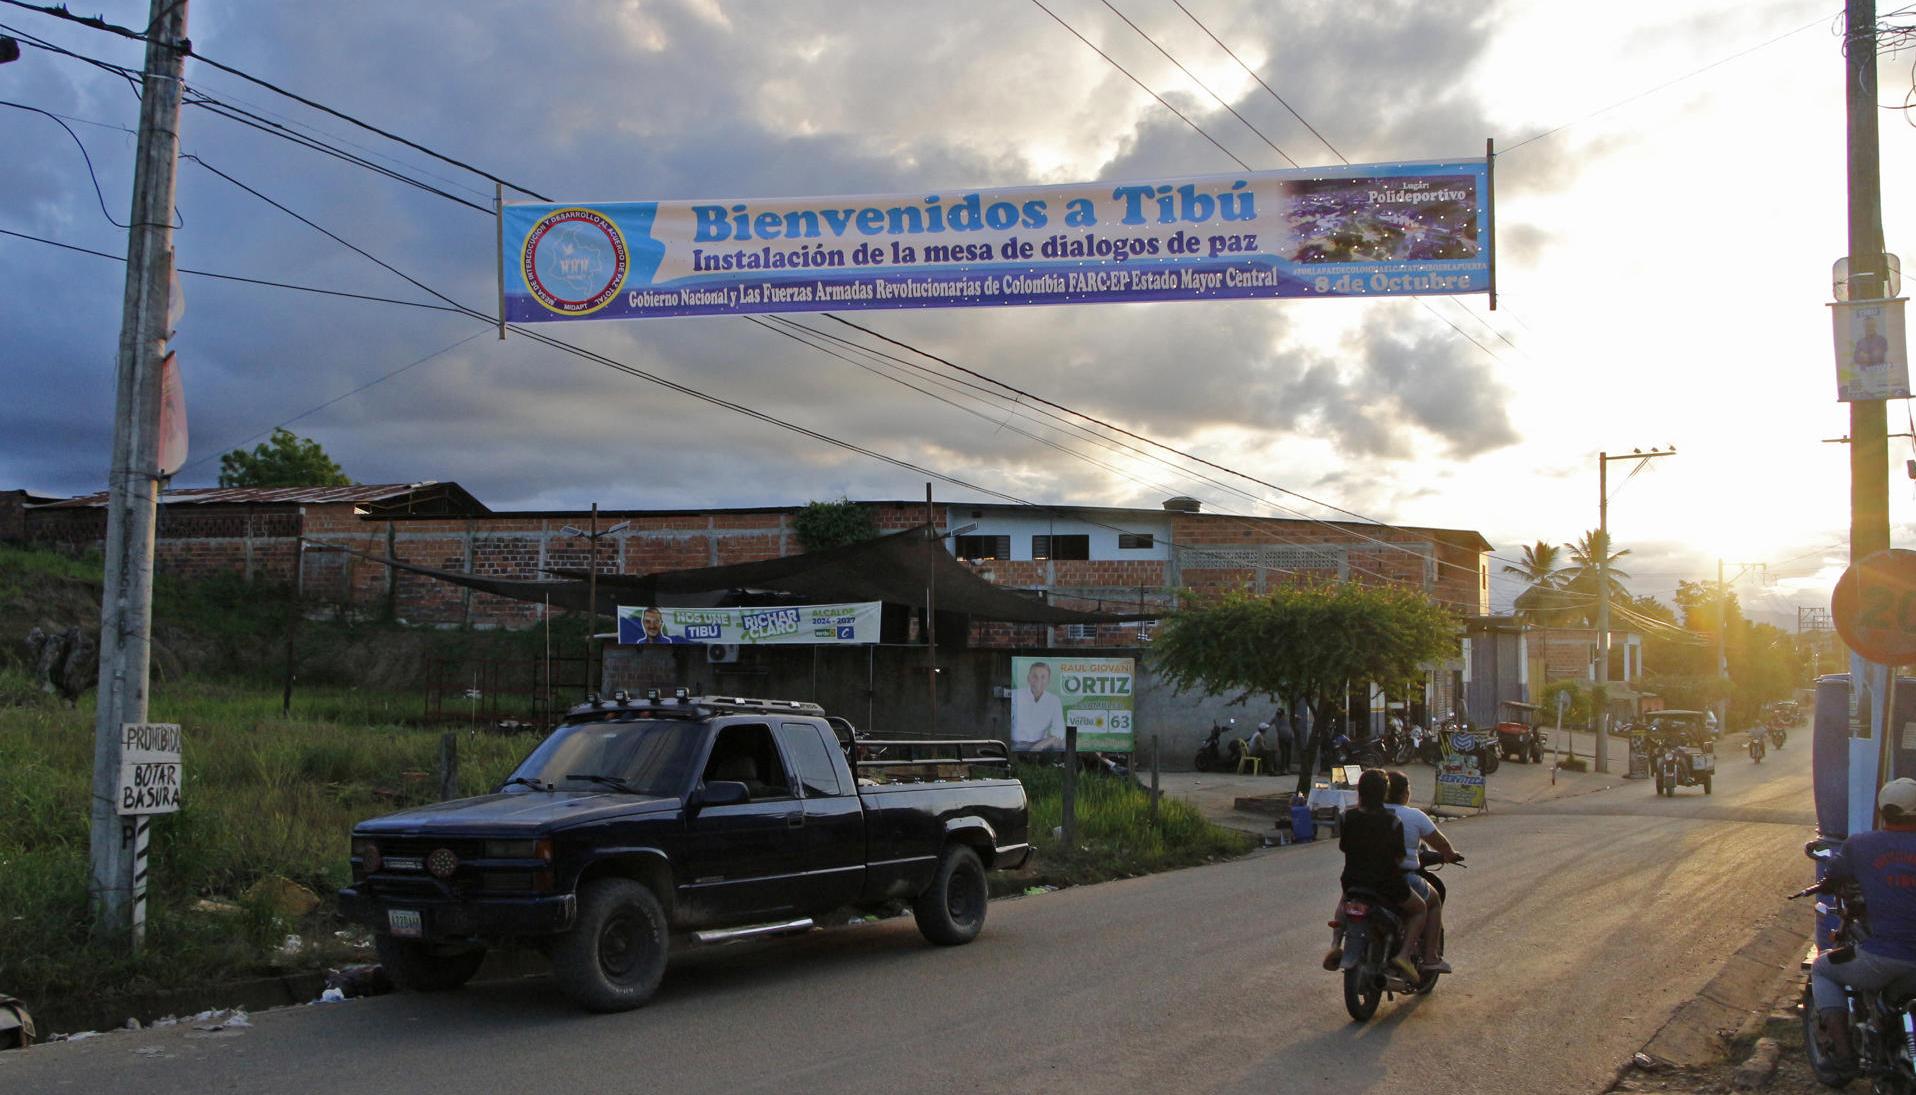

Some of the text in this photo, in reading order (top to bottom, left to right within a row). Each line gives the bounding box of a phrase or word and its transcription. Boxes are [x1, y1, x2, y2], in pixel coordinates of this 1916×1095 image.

[1368, 188, 1466, 204] Polideportivo
[691, 179, 1258, 243] Bienvenidos a Tibú
[693, 230, 1259, 272] Instalación de la mesa de dialogos de paz
[628, 290, 679, 308] Gobierno
[681, 288, 728, 306] Nacional
[739, 284, 761, 304] Las
[763, 282, 812, 303] Fuerzas
[815, 278, 873, 300] Armadas
[876, 272, 981, 299] Revolucionarias
[983, 274, 1000, 295] de
[1002, 272, 1066, 295] Colombia
[1131, 268, 1177, 291] Estado
[1181, 268, 1223, 293] Mayor
[1226, 266, 1278, 289] Central
[1335, 274, 1364, 292] de
[1370, 270, 1471, 291] Octubre
[676, 612, 730, 625] NOS UNE
[744, 609, 798, 629] RICHAR
[749, 621, 798, 639] CLARO
[1063, 675, 1130, 694] ORTIZ
[1110, 715, 1130, 729] 63
[134, 765, 176, 787] BOTAR
[123, 786, 180, 809] BASURA
